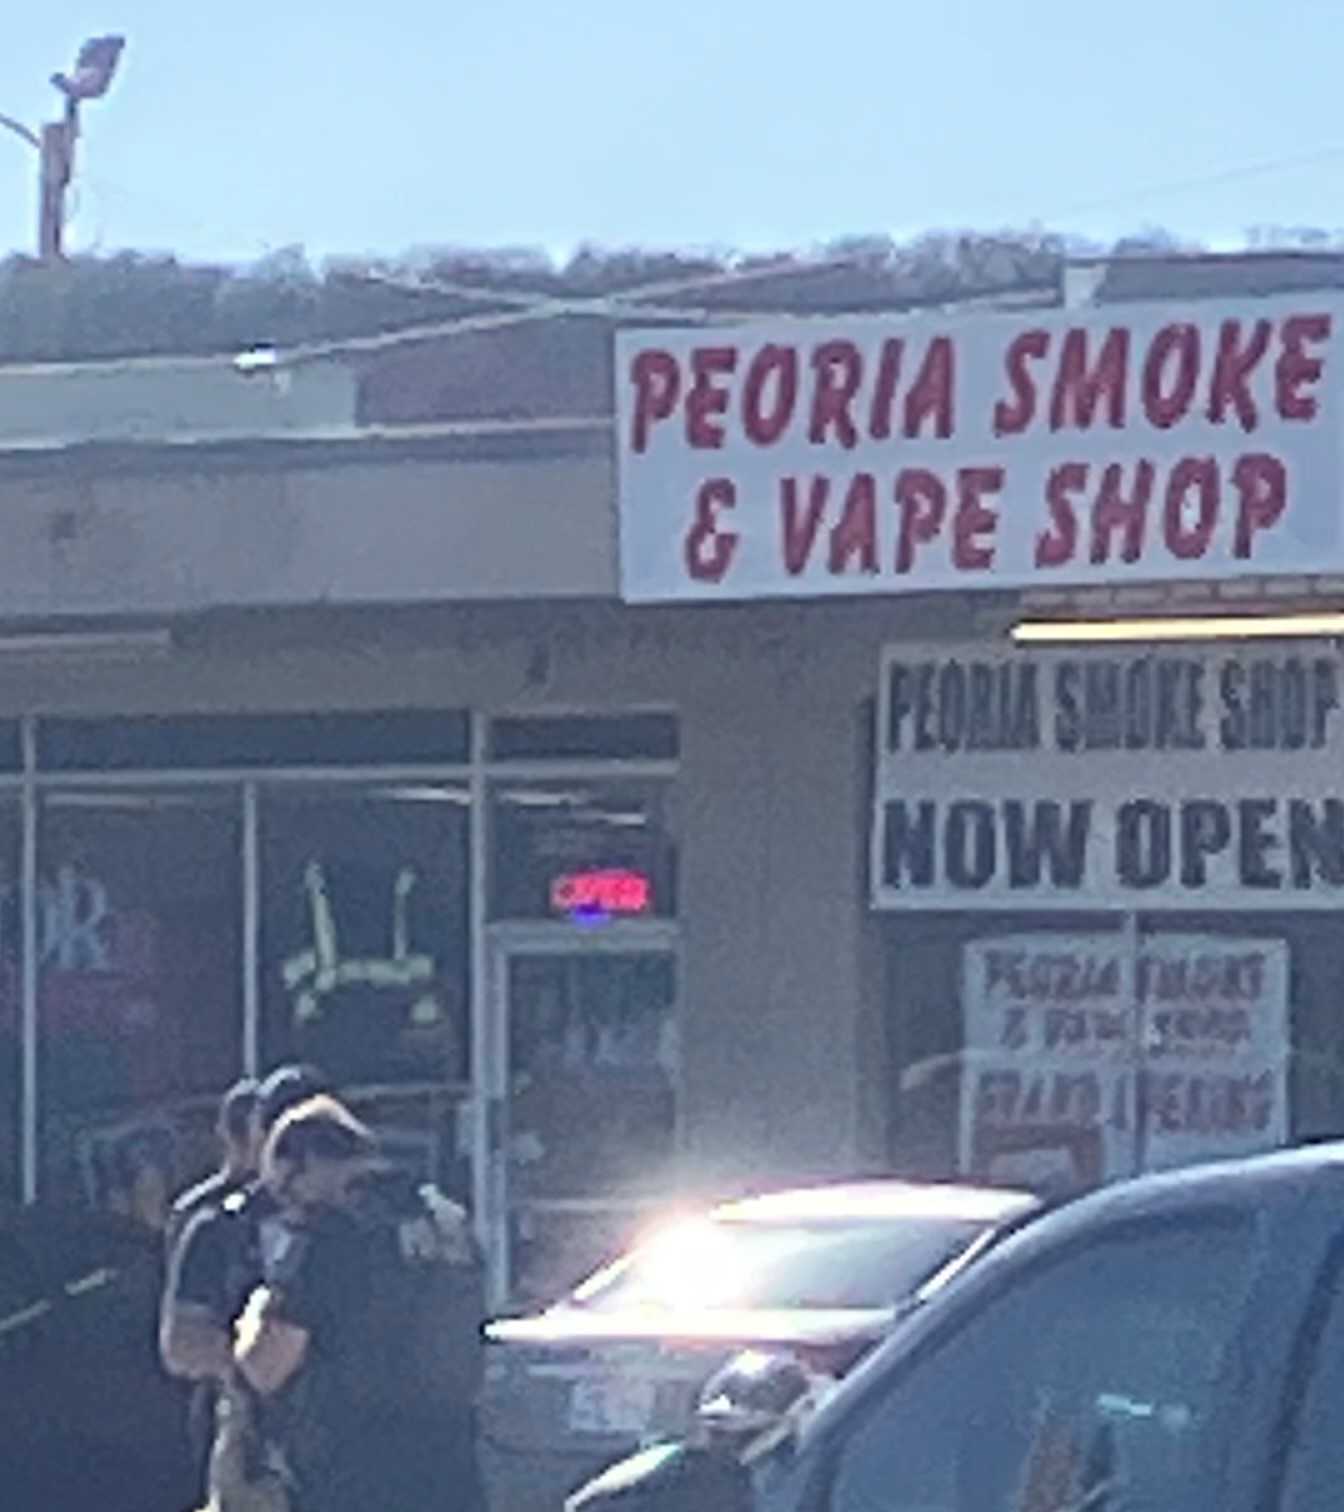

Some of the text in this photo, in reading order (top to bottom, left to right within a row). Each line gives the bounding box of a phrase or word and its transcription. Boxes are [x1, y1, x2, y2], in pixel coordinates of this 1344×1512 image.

[630, 313, 1332, 454] PEORIA SMOKE
[685, 453, 1288, 584] & VAPE SHOP
[889, 657, 1340, 753] PEORIA SMOKE SHOP
[882, 798, 1094, 890] NOW
